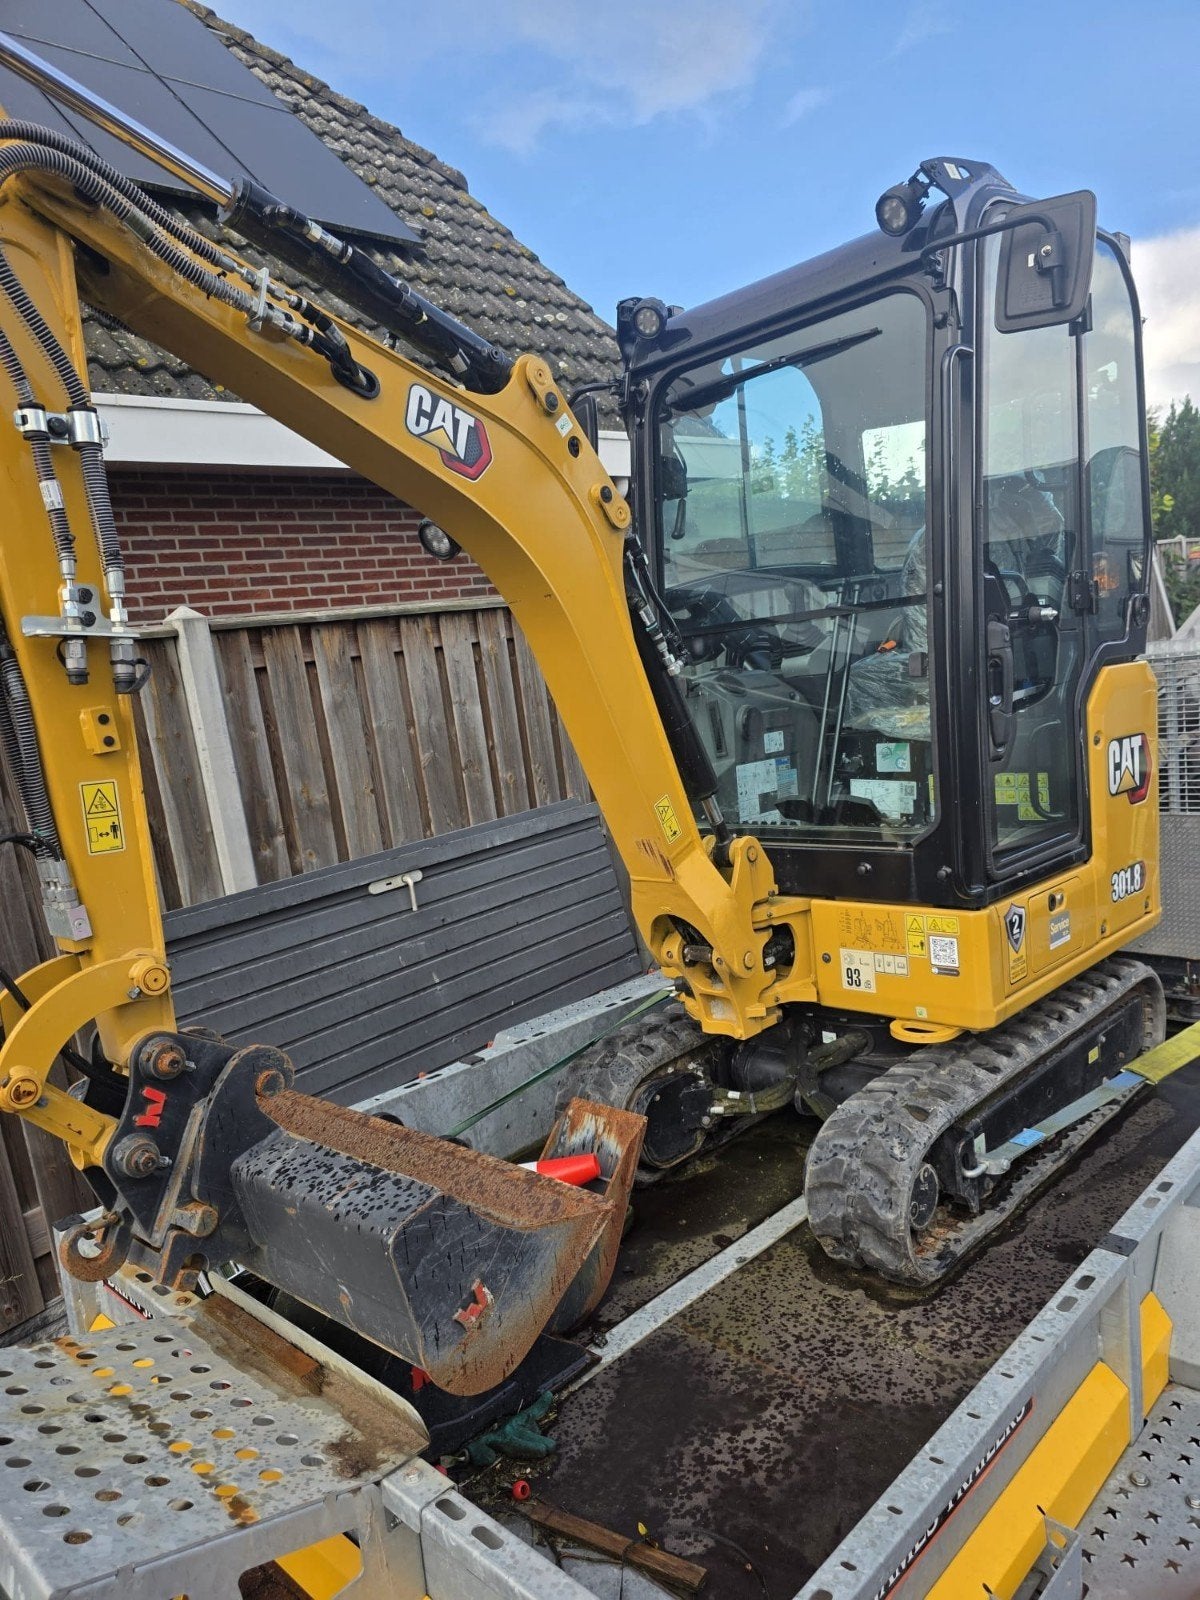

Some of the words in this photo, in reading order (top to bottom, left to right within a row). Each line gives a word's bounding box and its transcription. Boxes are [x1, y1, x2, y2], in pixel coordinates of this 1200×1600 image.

[406, 384, 475, 460] CAT
[1109, 734, 1142, 795] CAT
[1111, 864, 1141, 902] 301.8
[1012, 914, 1020, 933] 2
[846, 967, 861, 987] 93
